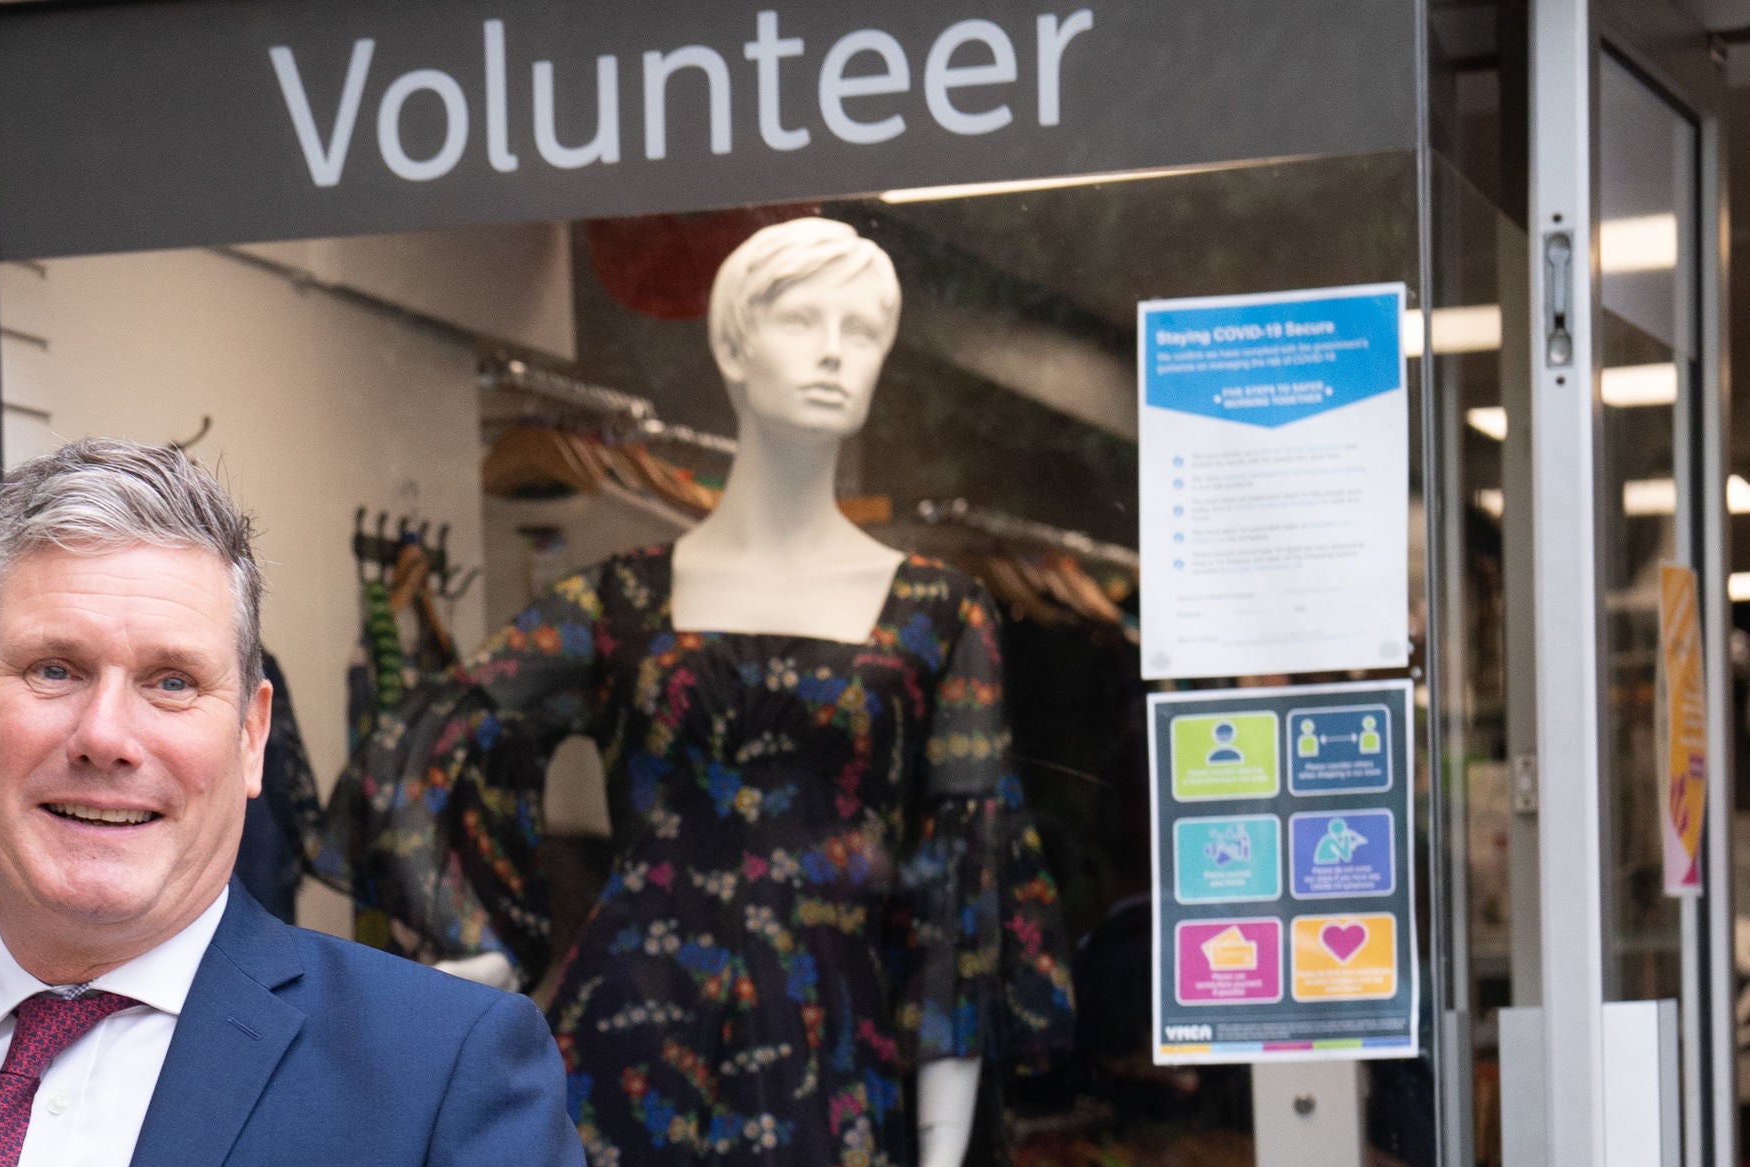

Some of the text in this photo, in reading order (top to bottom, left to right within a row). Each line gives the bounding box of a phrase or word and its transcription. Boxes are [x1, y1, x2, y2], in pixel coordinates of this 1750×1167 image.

[269, 9, 1094, 187] Volunteer
[1156, 320, 1335, 346] Staying COVID-19 Secure
[1164, 1023, 1213, 1041] YMCA
